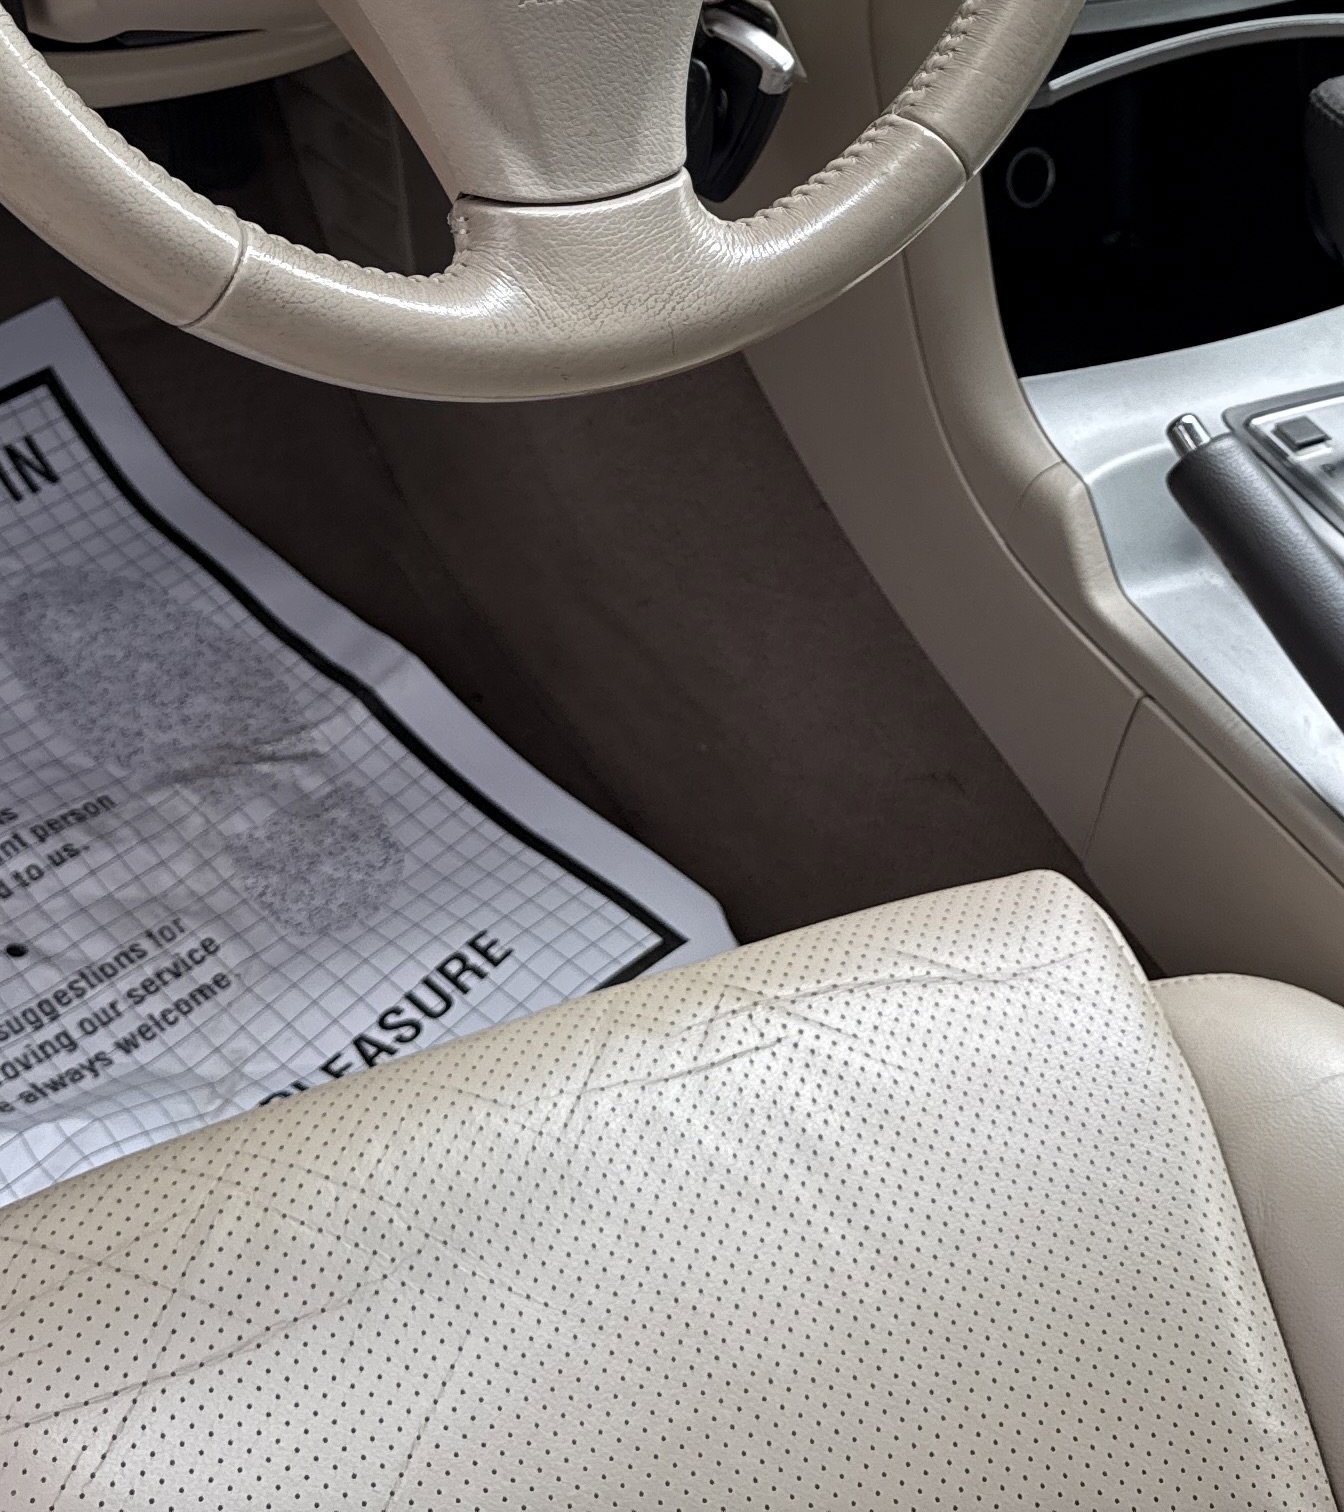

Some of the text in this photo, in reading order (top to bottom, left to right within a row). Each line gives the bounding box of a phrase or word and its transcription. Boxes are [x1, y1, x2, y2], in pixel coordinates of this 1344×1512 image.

[30, 792, 118, 846] person
[13, 861, 45, 888] to
[48, 838, 90, 870] us.
[144, 916, 187, 950] for
[77, 998, 125, 1037] our
[125, 934, 222, 1007] service
[17, 1048, 116, 1107] always
